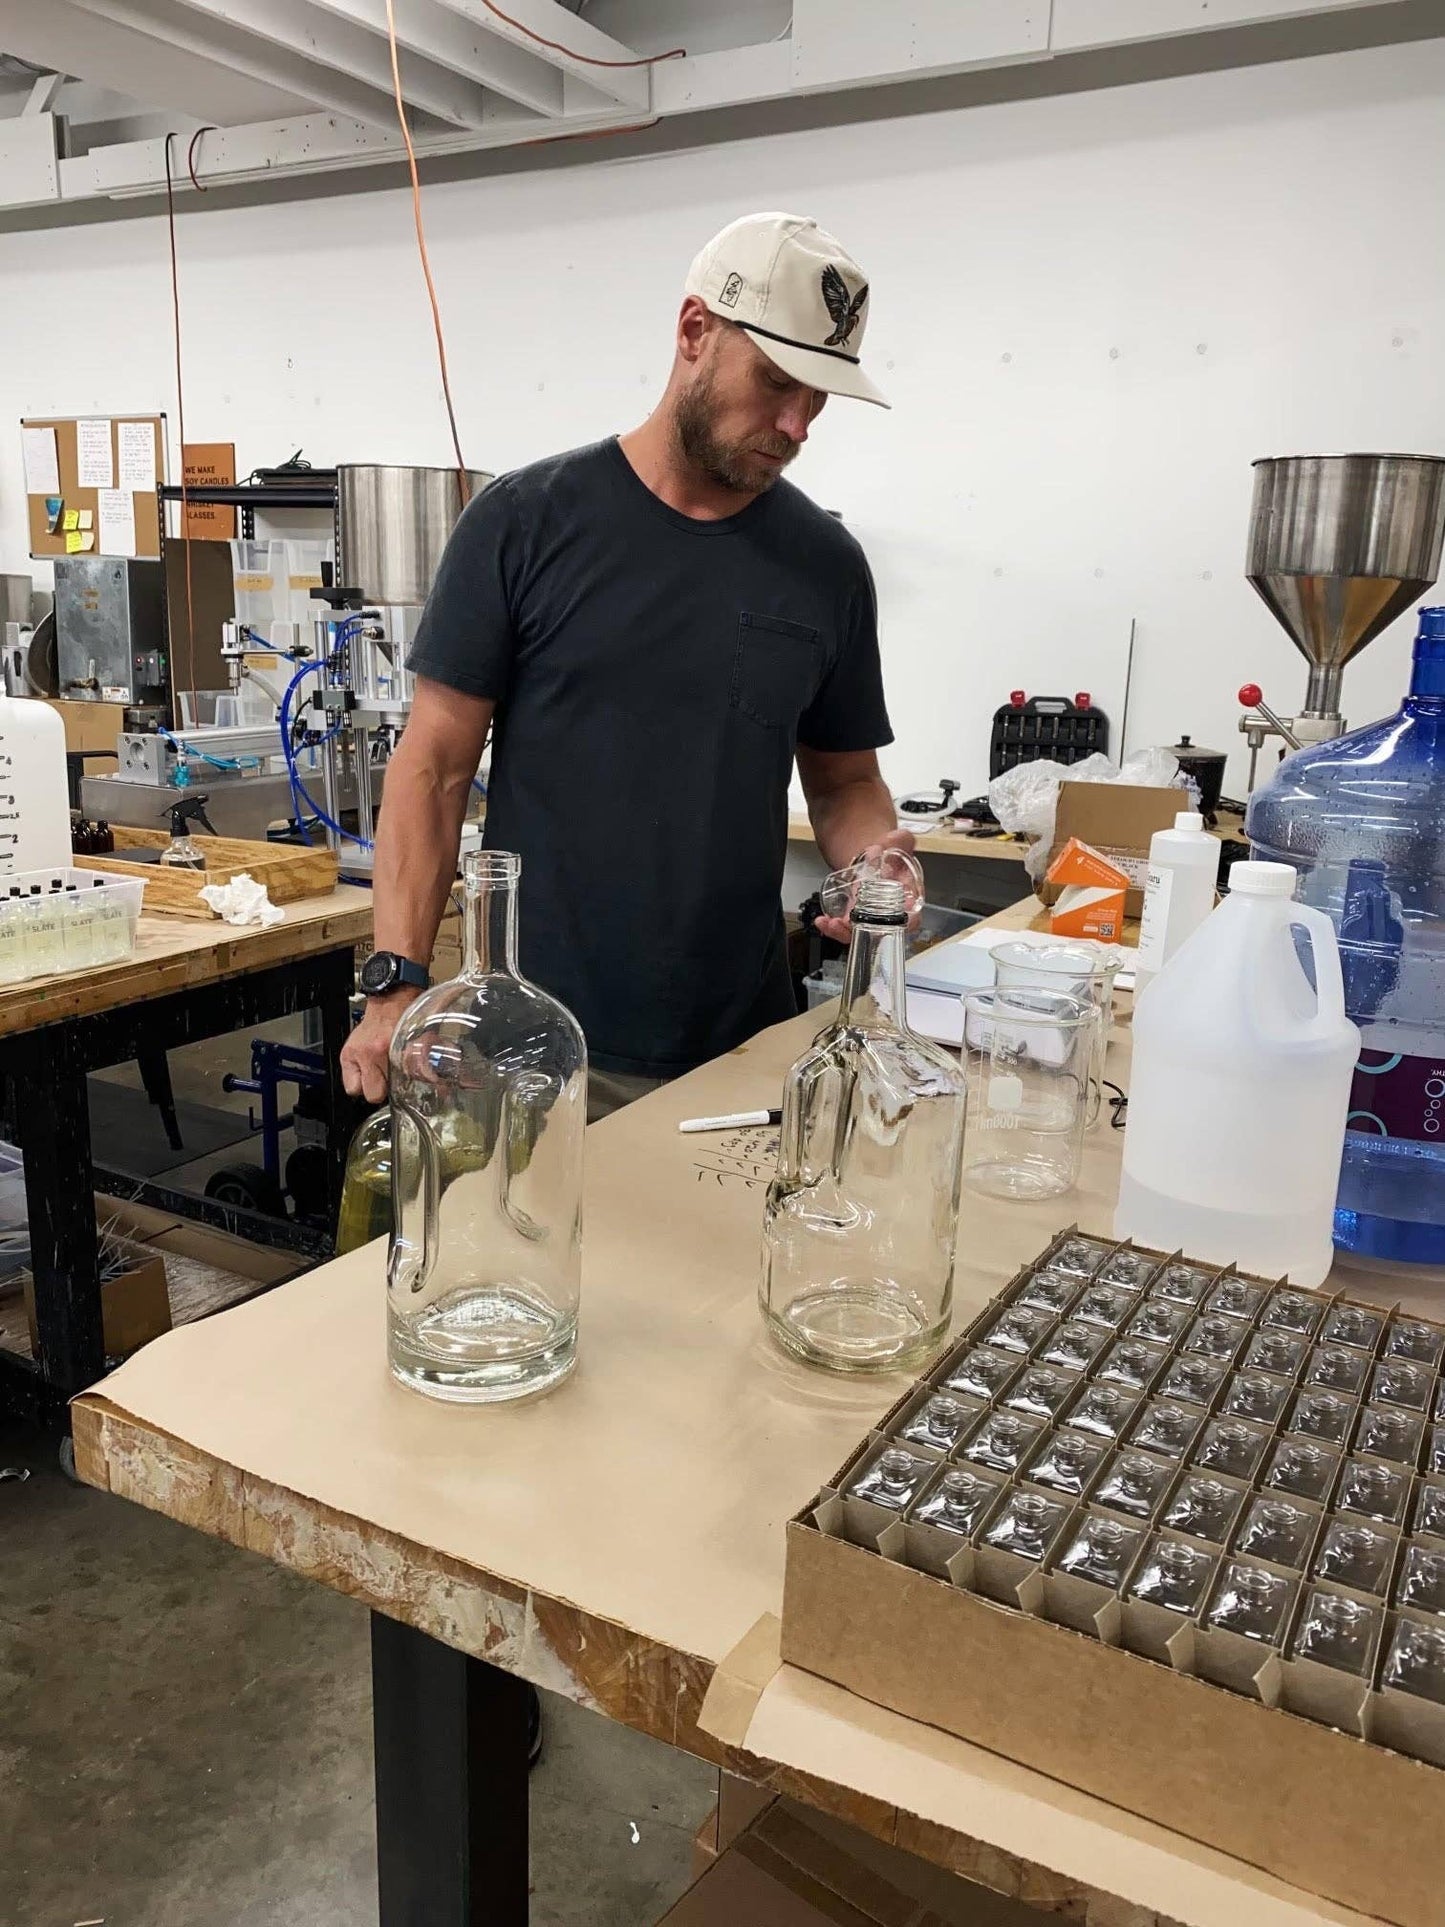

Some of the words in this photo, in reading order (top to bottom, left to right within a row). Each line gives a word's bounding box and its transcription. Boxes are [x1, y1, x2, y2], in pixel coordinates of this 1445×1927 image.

[185, 466, 196, 474] WE
[197, 466, 215, 474] MAKE
[184, 477, 198, 485] SOY
[200, 477, 229, 485] CANDLES
[12, 833, 19, 843] 2
[31, 922, 56, 933] SLATE
